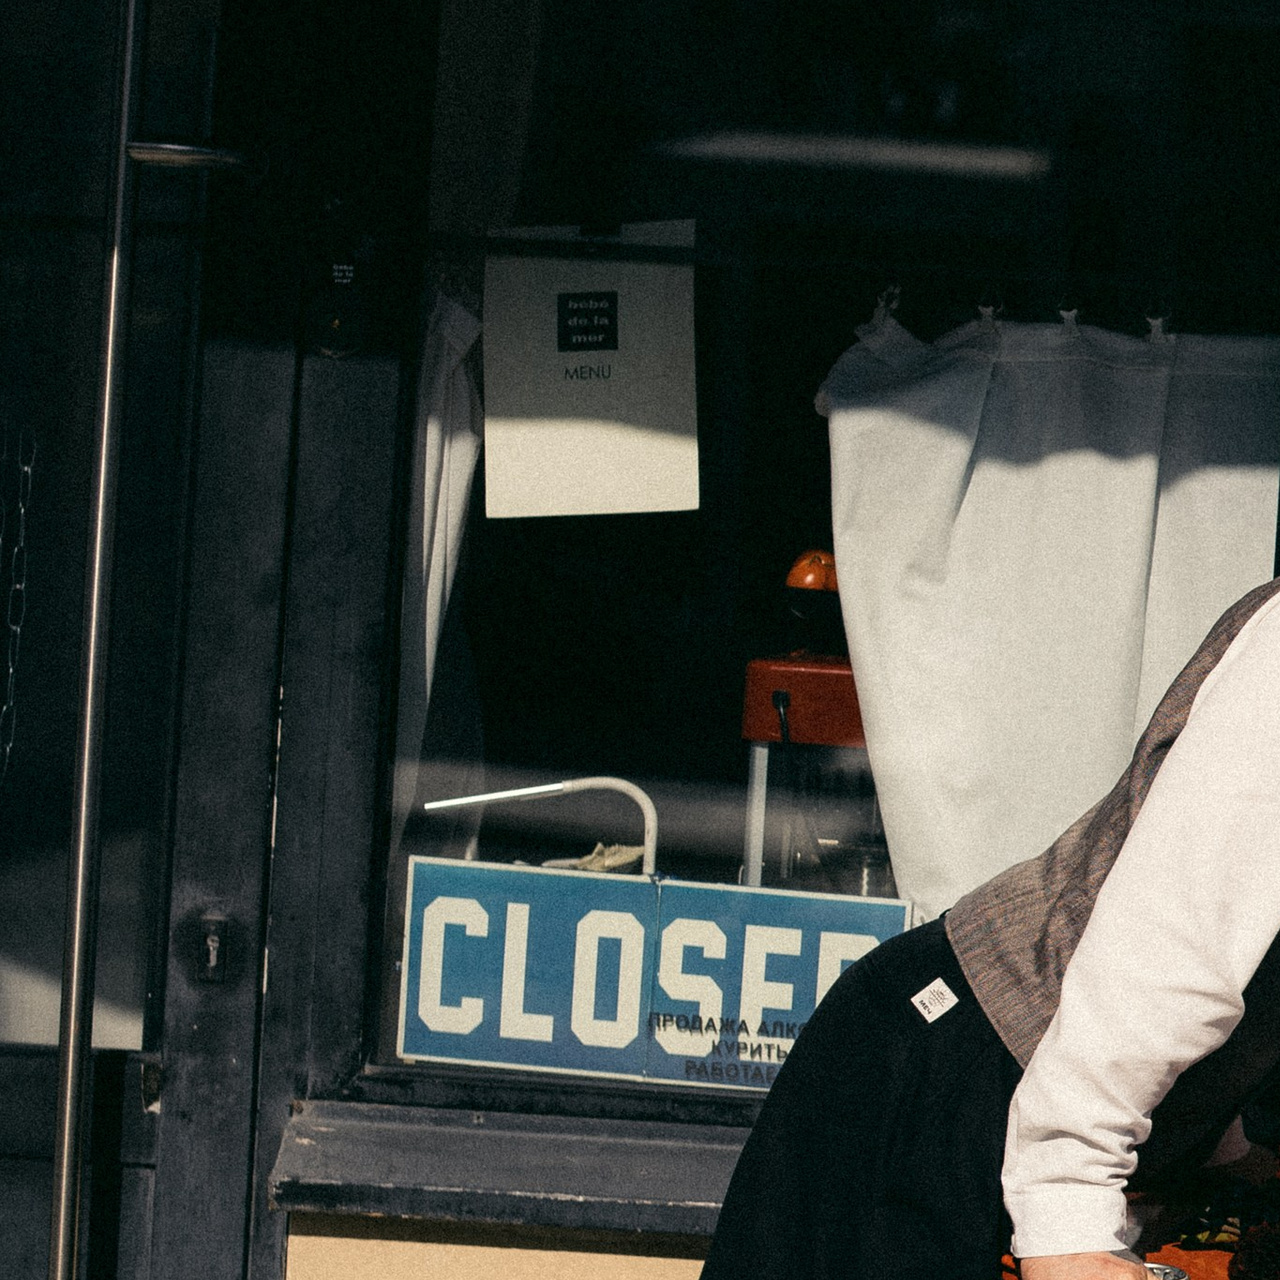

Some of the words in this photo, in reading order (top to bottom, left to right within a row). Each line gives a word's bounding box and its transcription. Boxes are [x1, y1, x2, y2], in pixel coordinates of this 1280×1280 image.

[594, 315, 609, 326] la
[572, 333, 604, 343] mer
[564, 364, 611, 380] MENU
[649, 1012, 750, 1036] ПРОДАЖА
[712, 1039, 788, 1061] КУРИТЬ
